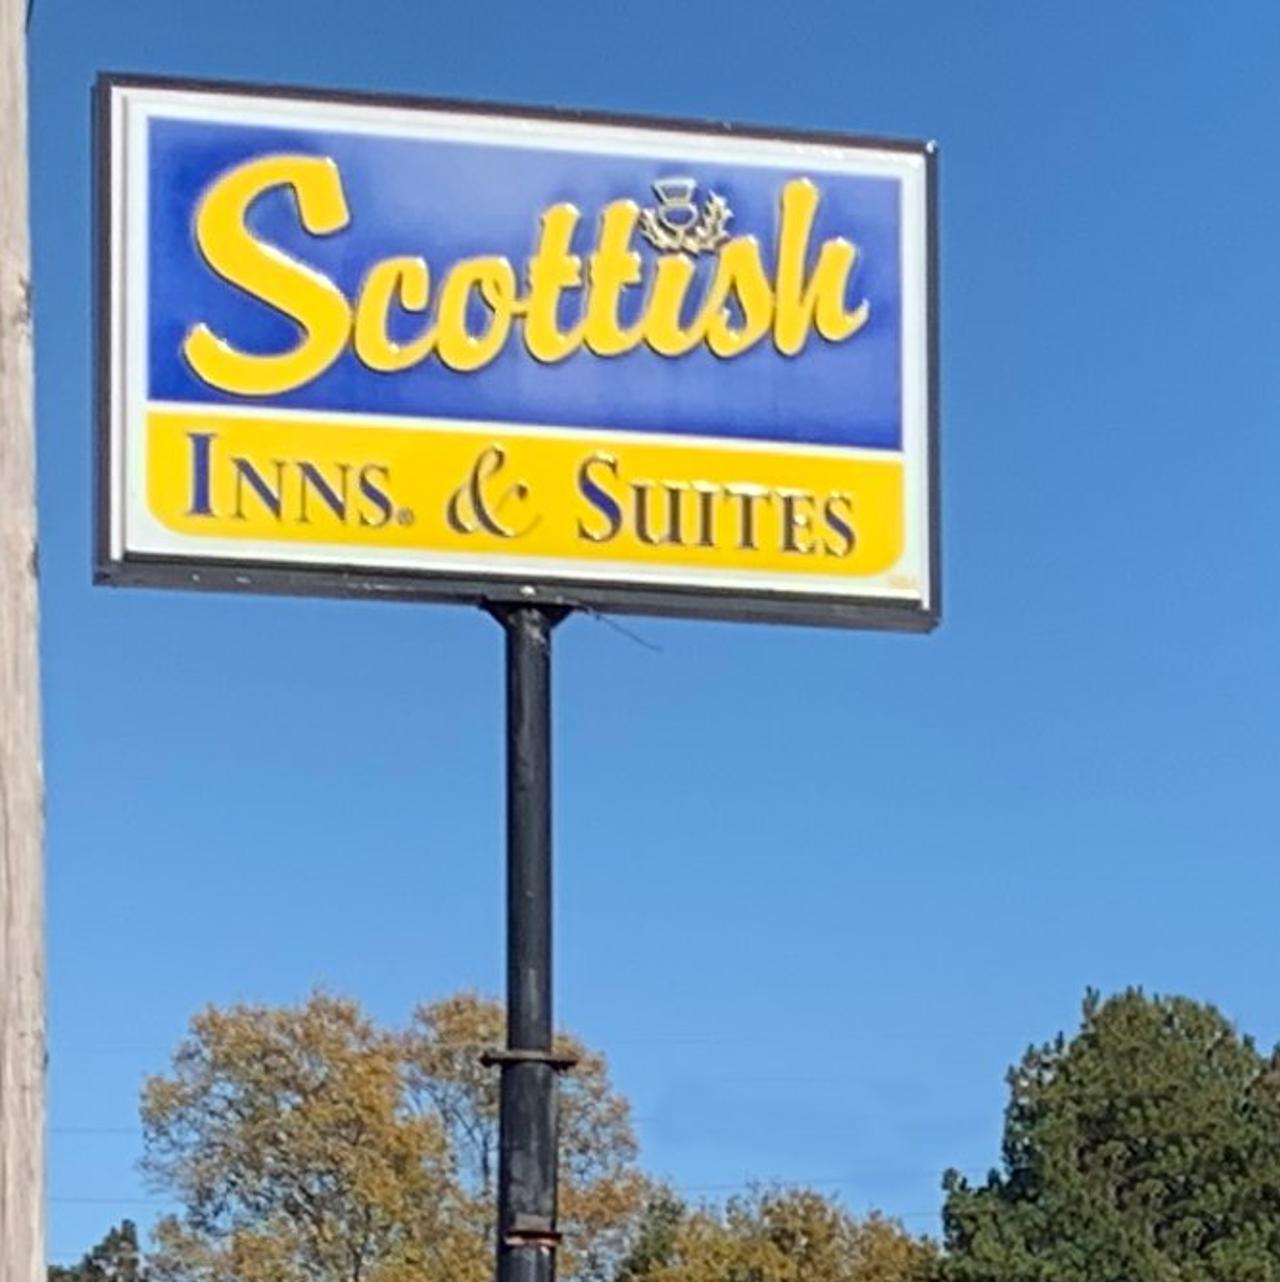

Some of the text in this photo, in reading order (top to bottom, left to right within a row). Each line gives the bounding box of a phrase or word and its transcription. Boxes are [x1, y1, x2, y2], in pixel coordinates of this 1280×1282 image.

[182, 152, 869, 398] Scottish
[446, 443, 541, 540] &
[576, 450, 858, 559] SUITES
